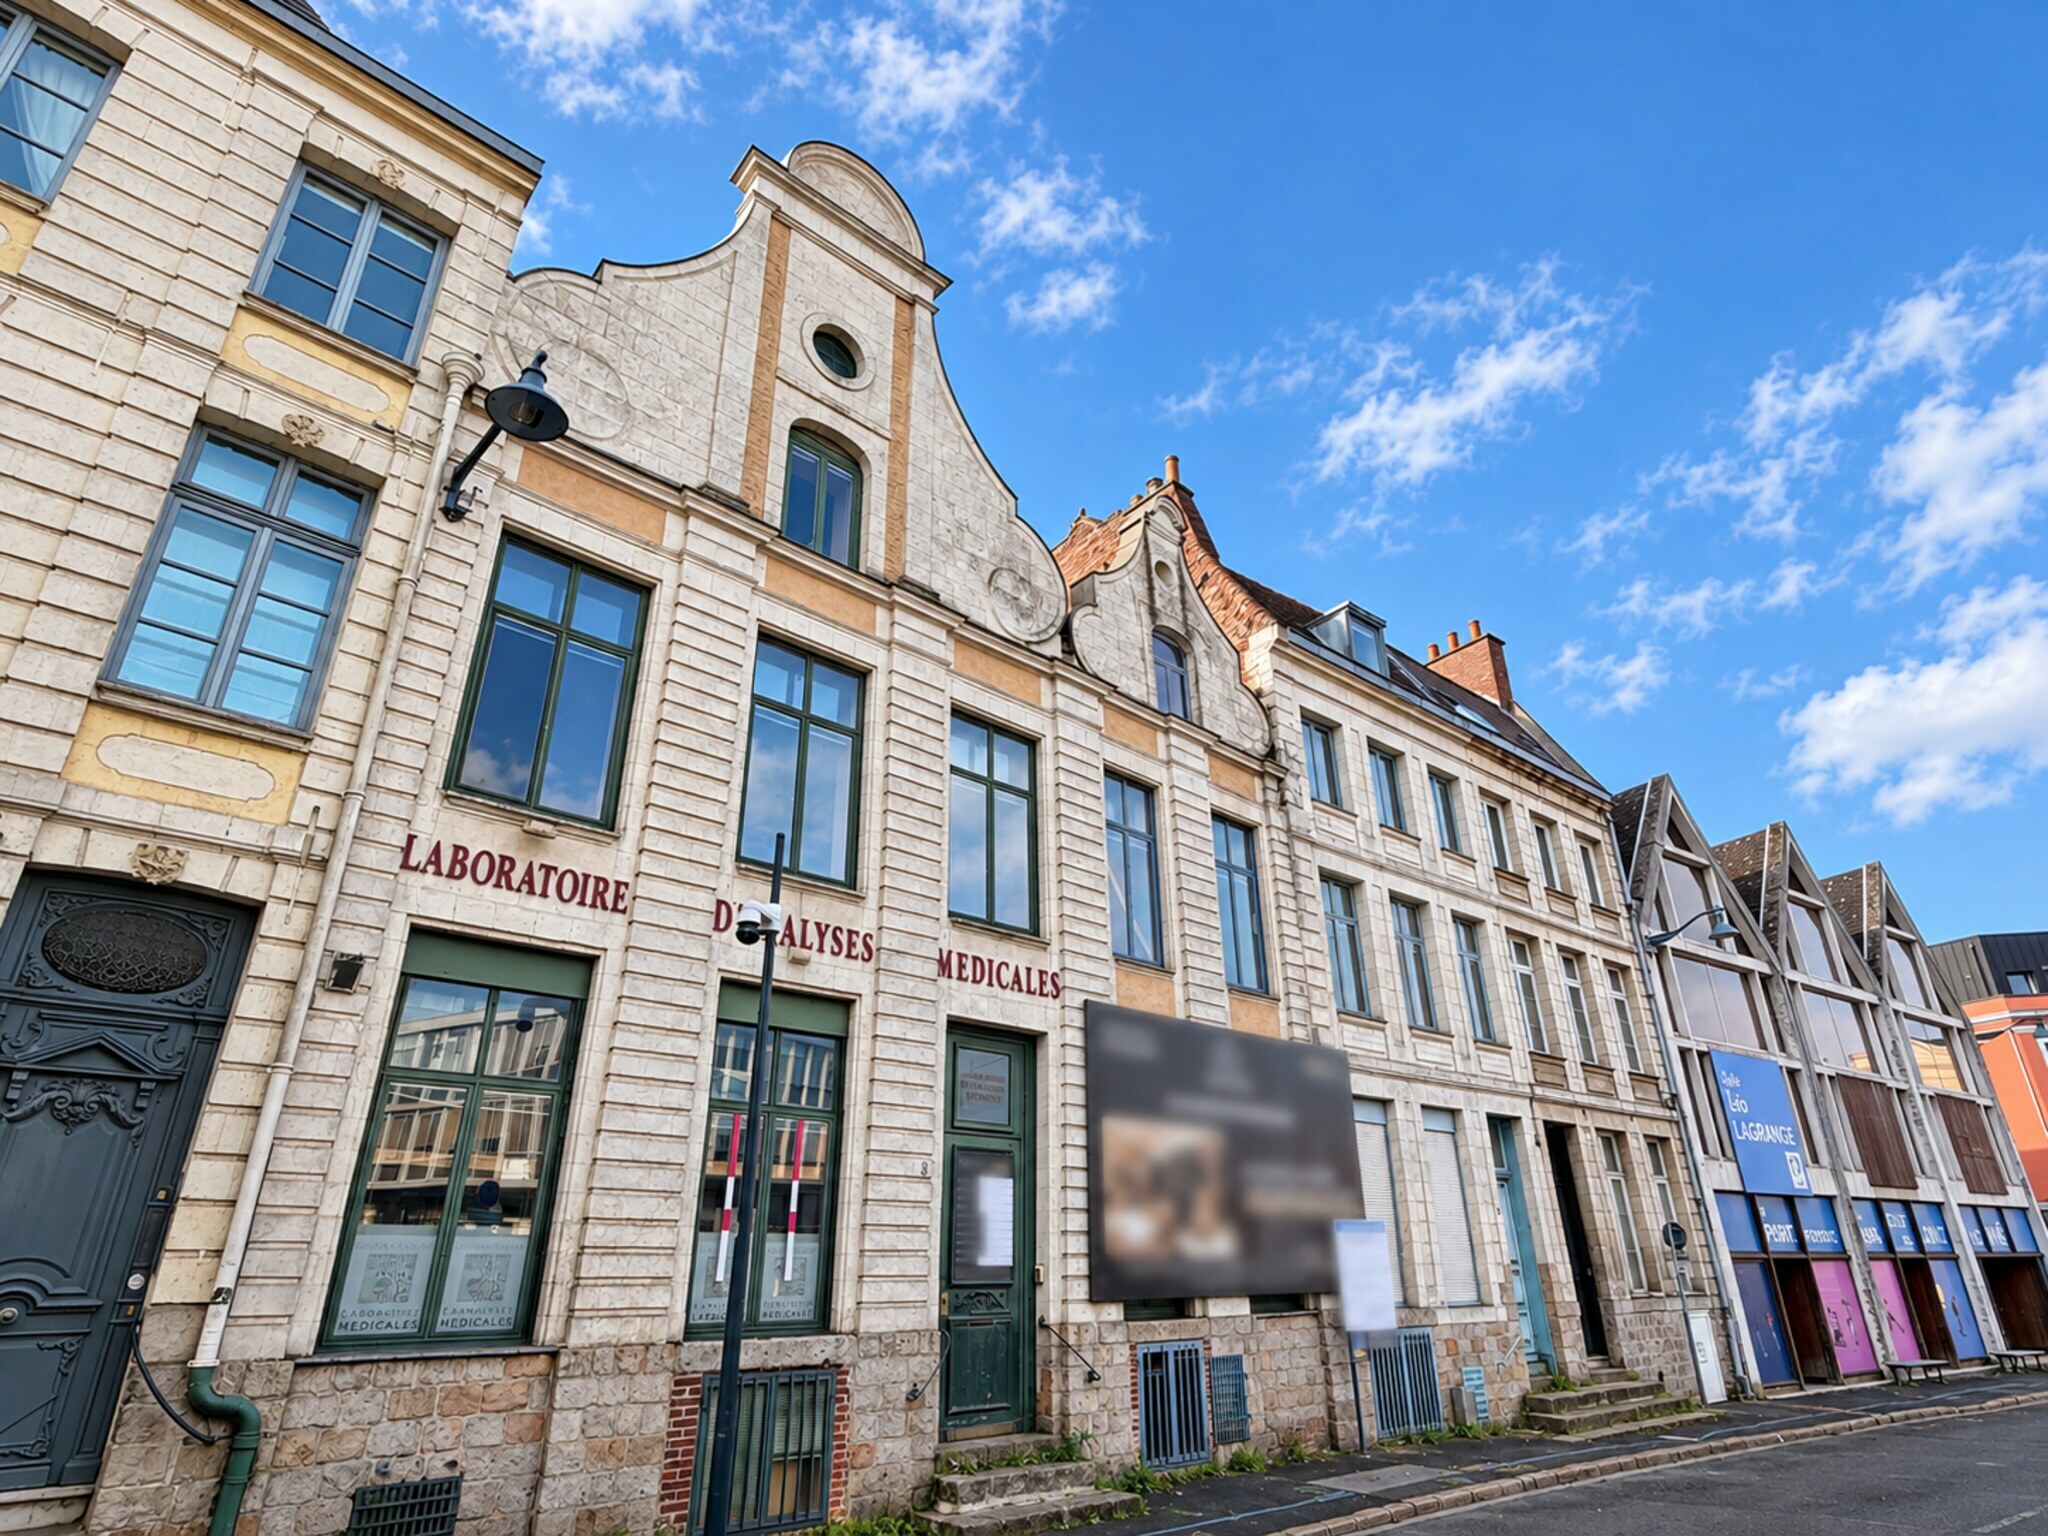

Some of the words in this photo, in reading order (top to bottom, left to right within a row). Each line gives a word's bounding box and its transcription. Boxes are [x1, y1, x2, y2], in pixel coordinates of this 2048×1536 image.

[399, 833, 630, 915] LABORATOIRE
[712, 898, 874, 963] D'ALYSES
[937, 947, 1061, 1000] MEDICALES
[1732, 1120, 1796, 1145] LAGRANGE
